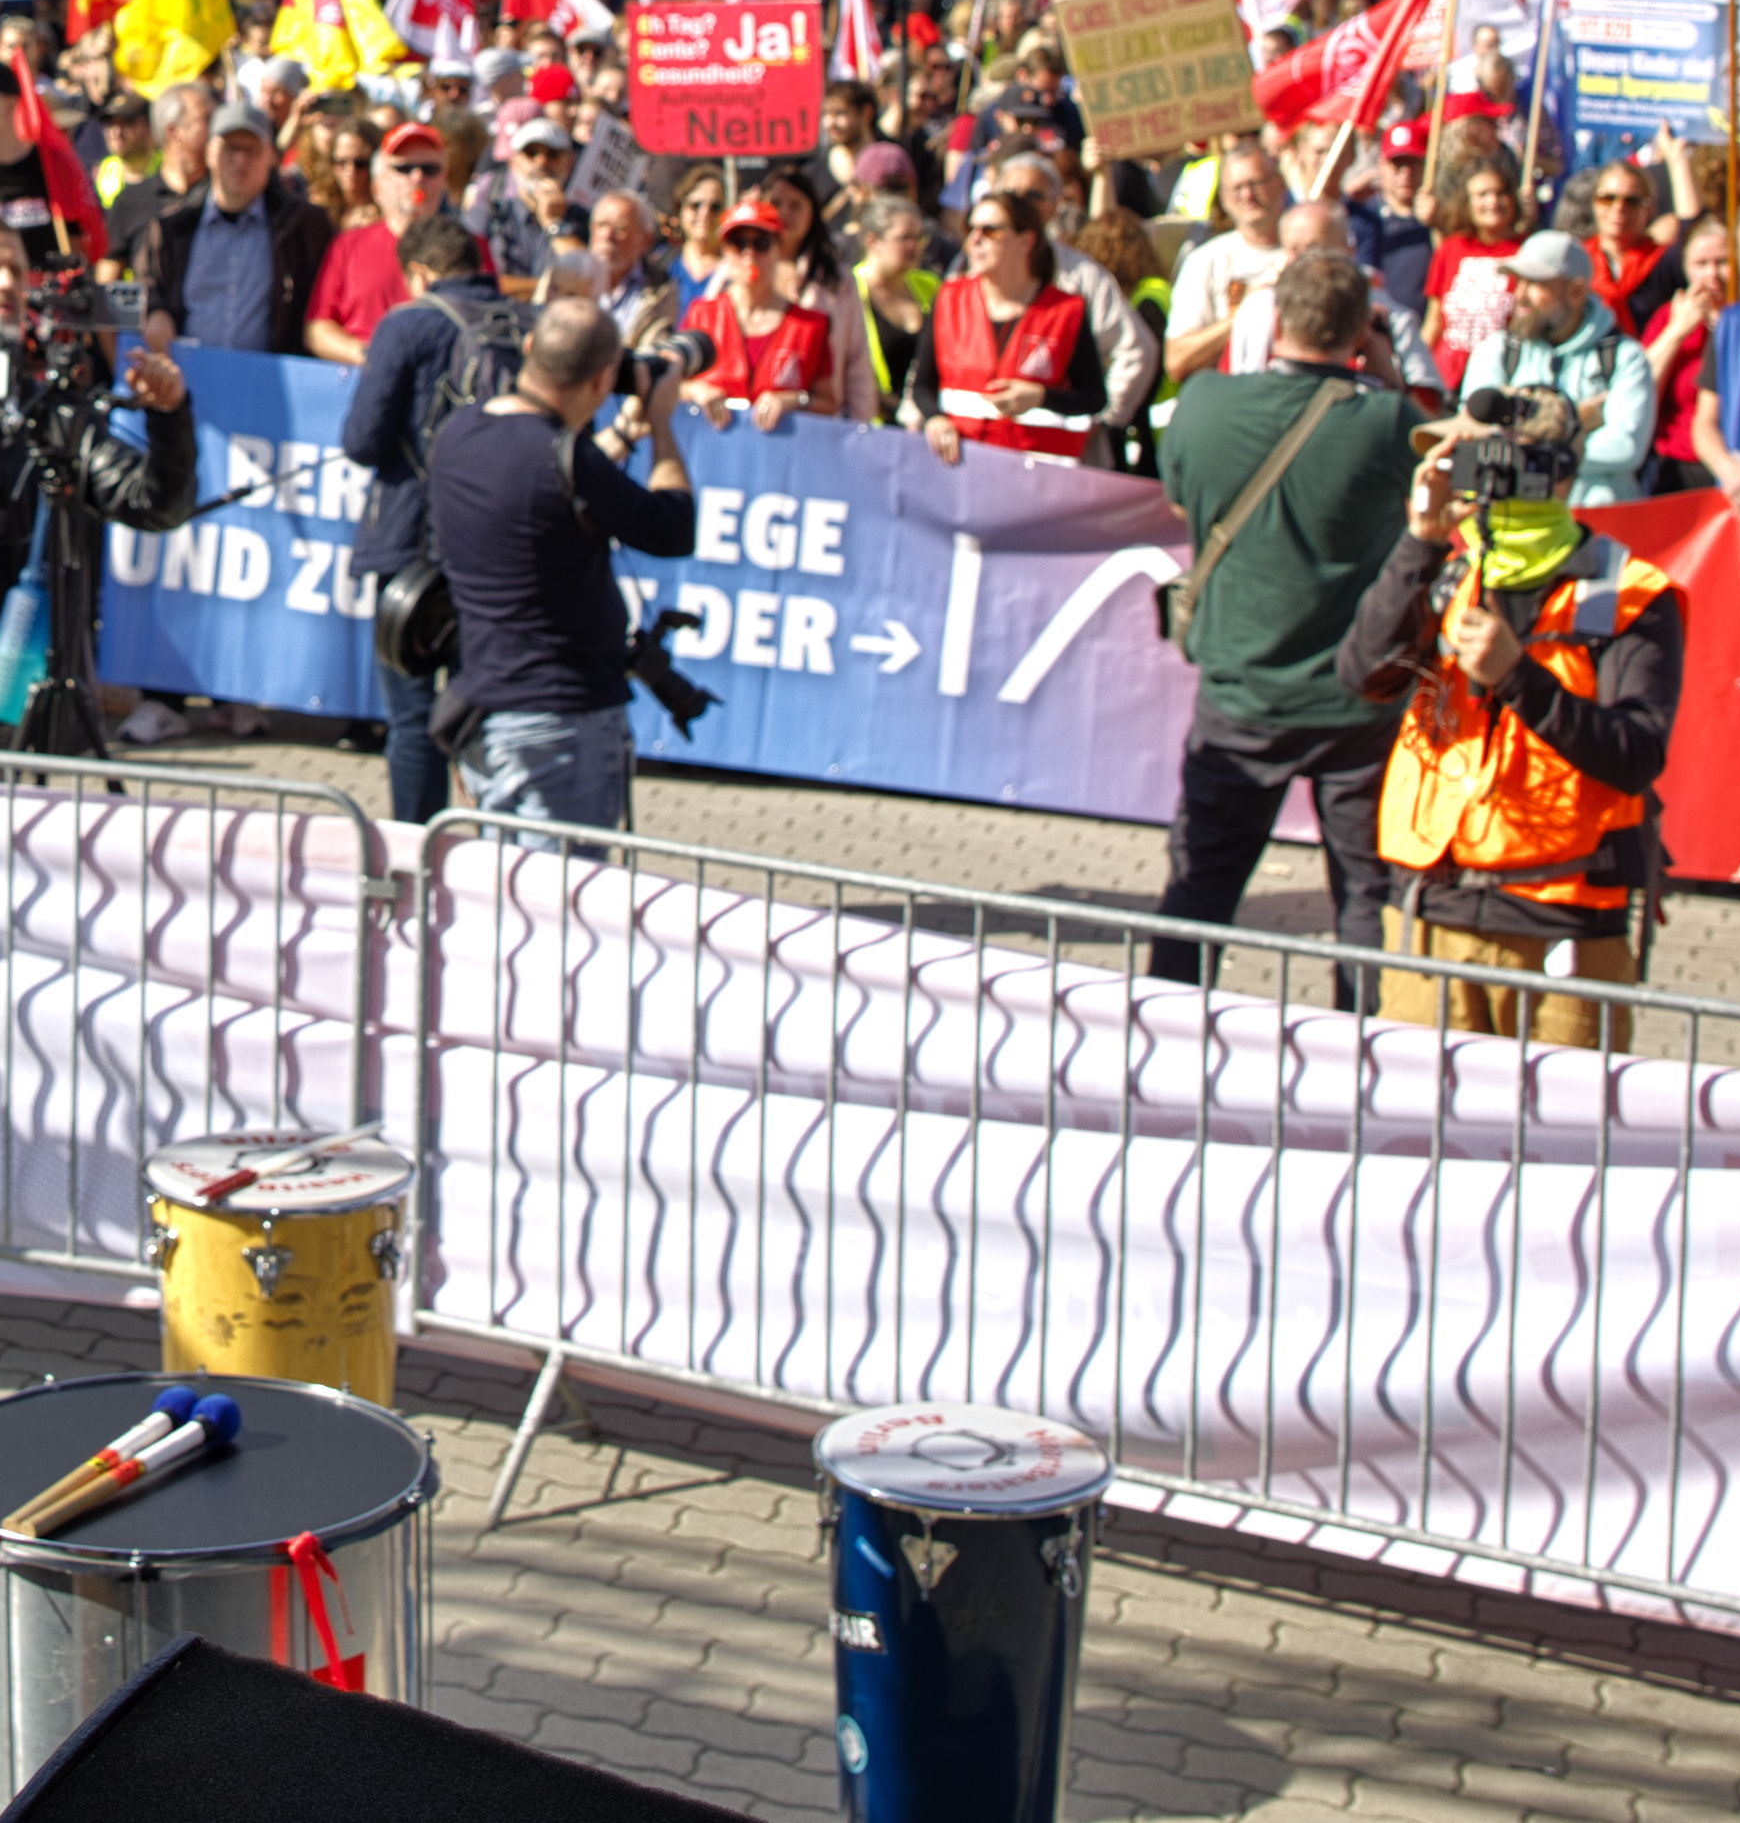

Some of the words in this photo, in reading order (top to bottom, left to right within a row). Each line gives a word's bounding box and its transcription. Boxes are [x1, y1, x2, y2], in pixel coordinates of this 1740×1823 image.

[666, 12, 717, 37] Tag?
[723, 11, 810, 64] Ja!
[637, 38, 710, 61] Rente?
[638, 63, 765, 86] Gesundheit?
[687, 107, 809, 147] Nein!
[110, 522, 272, 602] UND
[676, 583, 839, 676] DER
